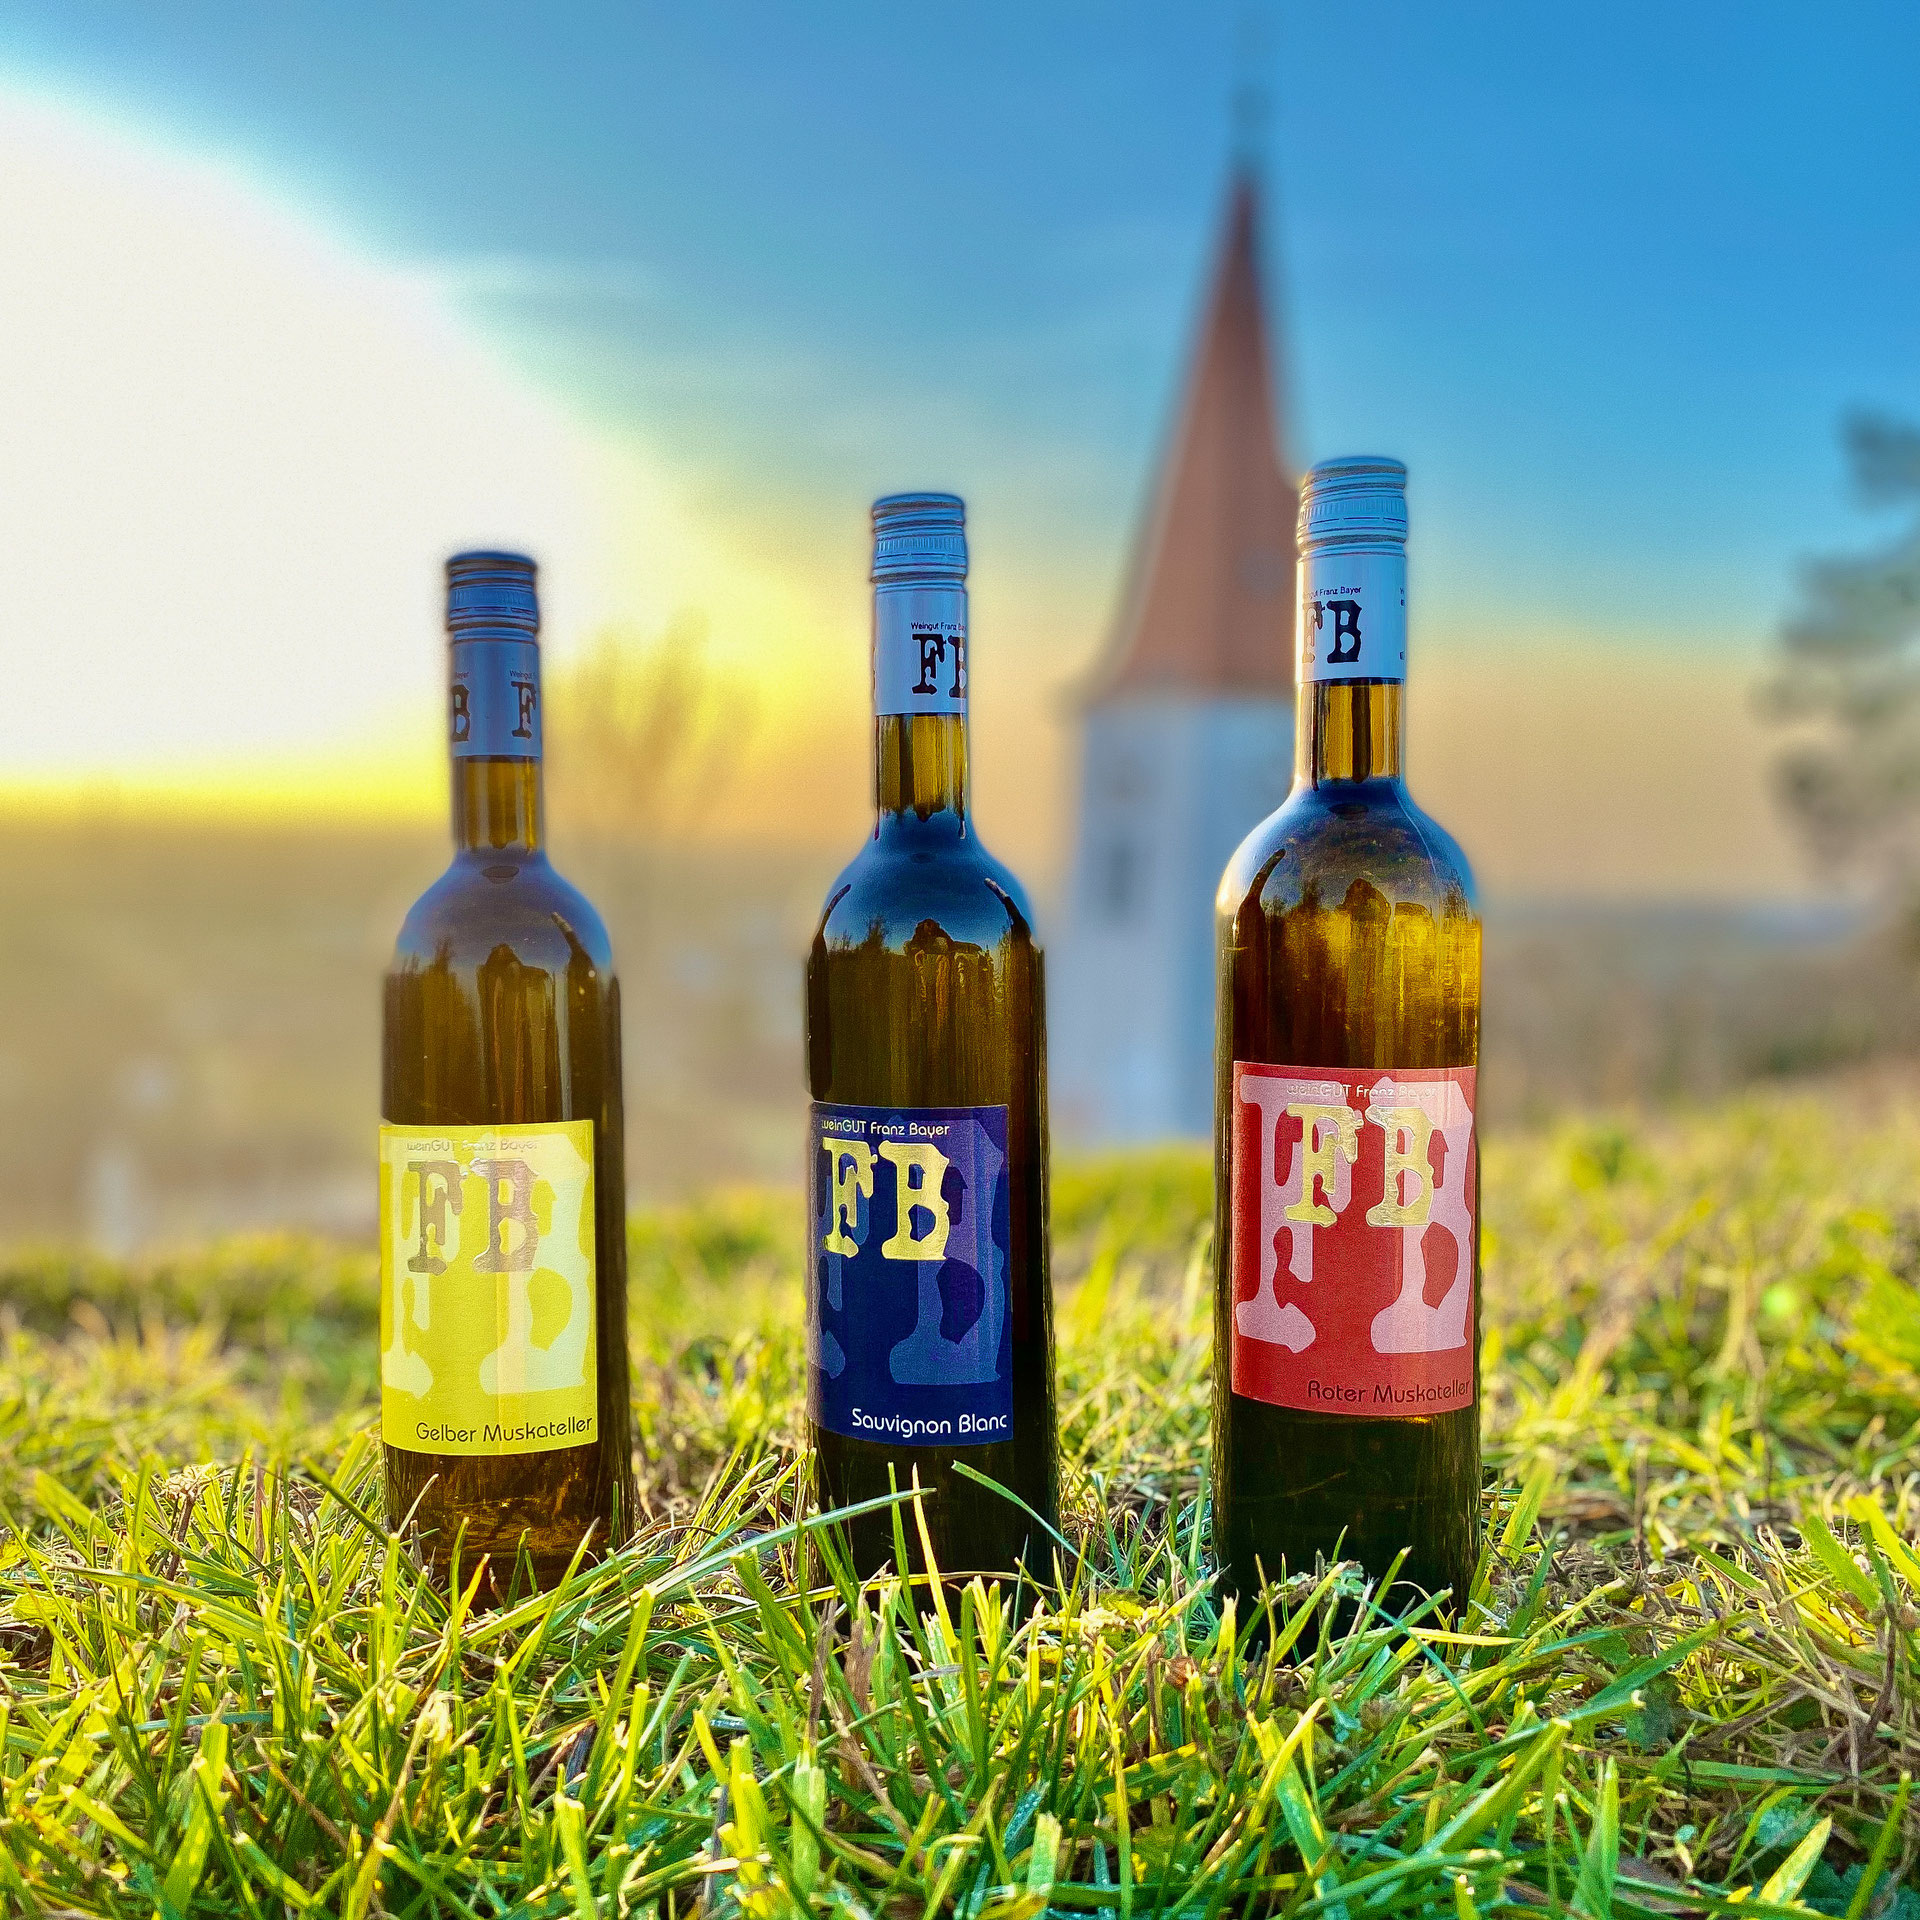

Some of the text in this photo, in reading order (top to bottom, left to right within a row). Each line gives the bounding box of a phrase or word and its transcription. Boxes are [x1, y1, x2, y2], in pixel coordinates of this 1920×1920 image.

[1320, 588, 1338, 596] Franz
[1340, 586, 1362, 596] Bayer
[910, 622, 939, 631] Weingut
[940, 622, 957, 631] Franz
[1286, 1082, 1437, 1101] weinGUT Franz Bayer
[821, 1119, 950, 1139] weinGUT Franz Bayer
[407, 1139, 456, 1151] weinGUT
[1284, 1103, 1436, 1228] FB
[822, 1137, 950, 1260] FB
[407, 1157, 540, 1276] FB
[1307, 1378, 1471, 1403] Roter Muskateller
[416, 1416, 593, 1443] Gelber Muskateller
[852, 1408, 1007, 1438] Sauvignon Blanc
